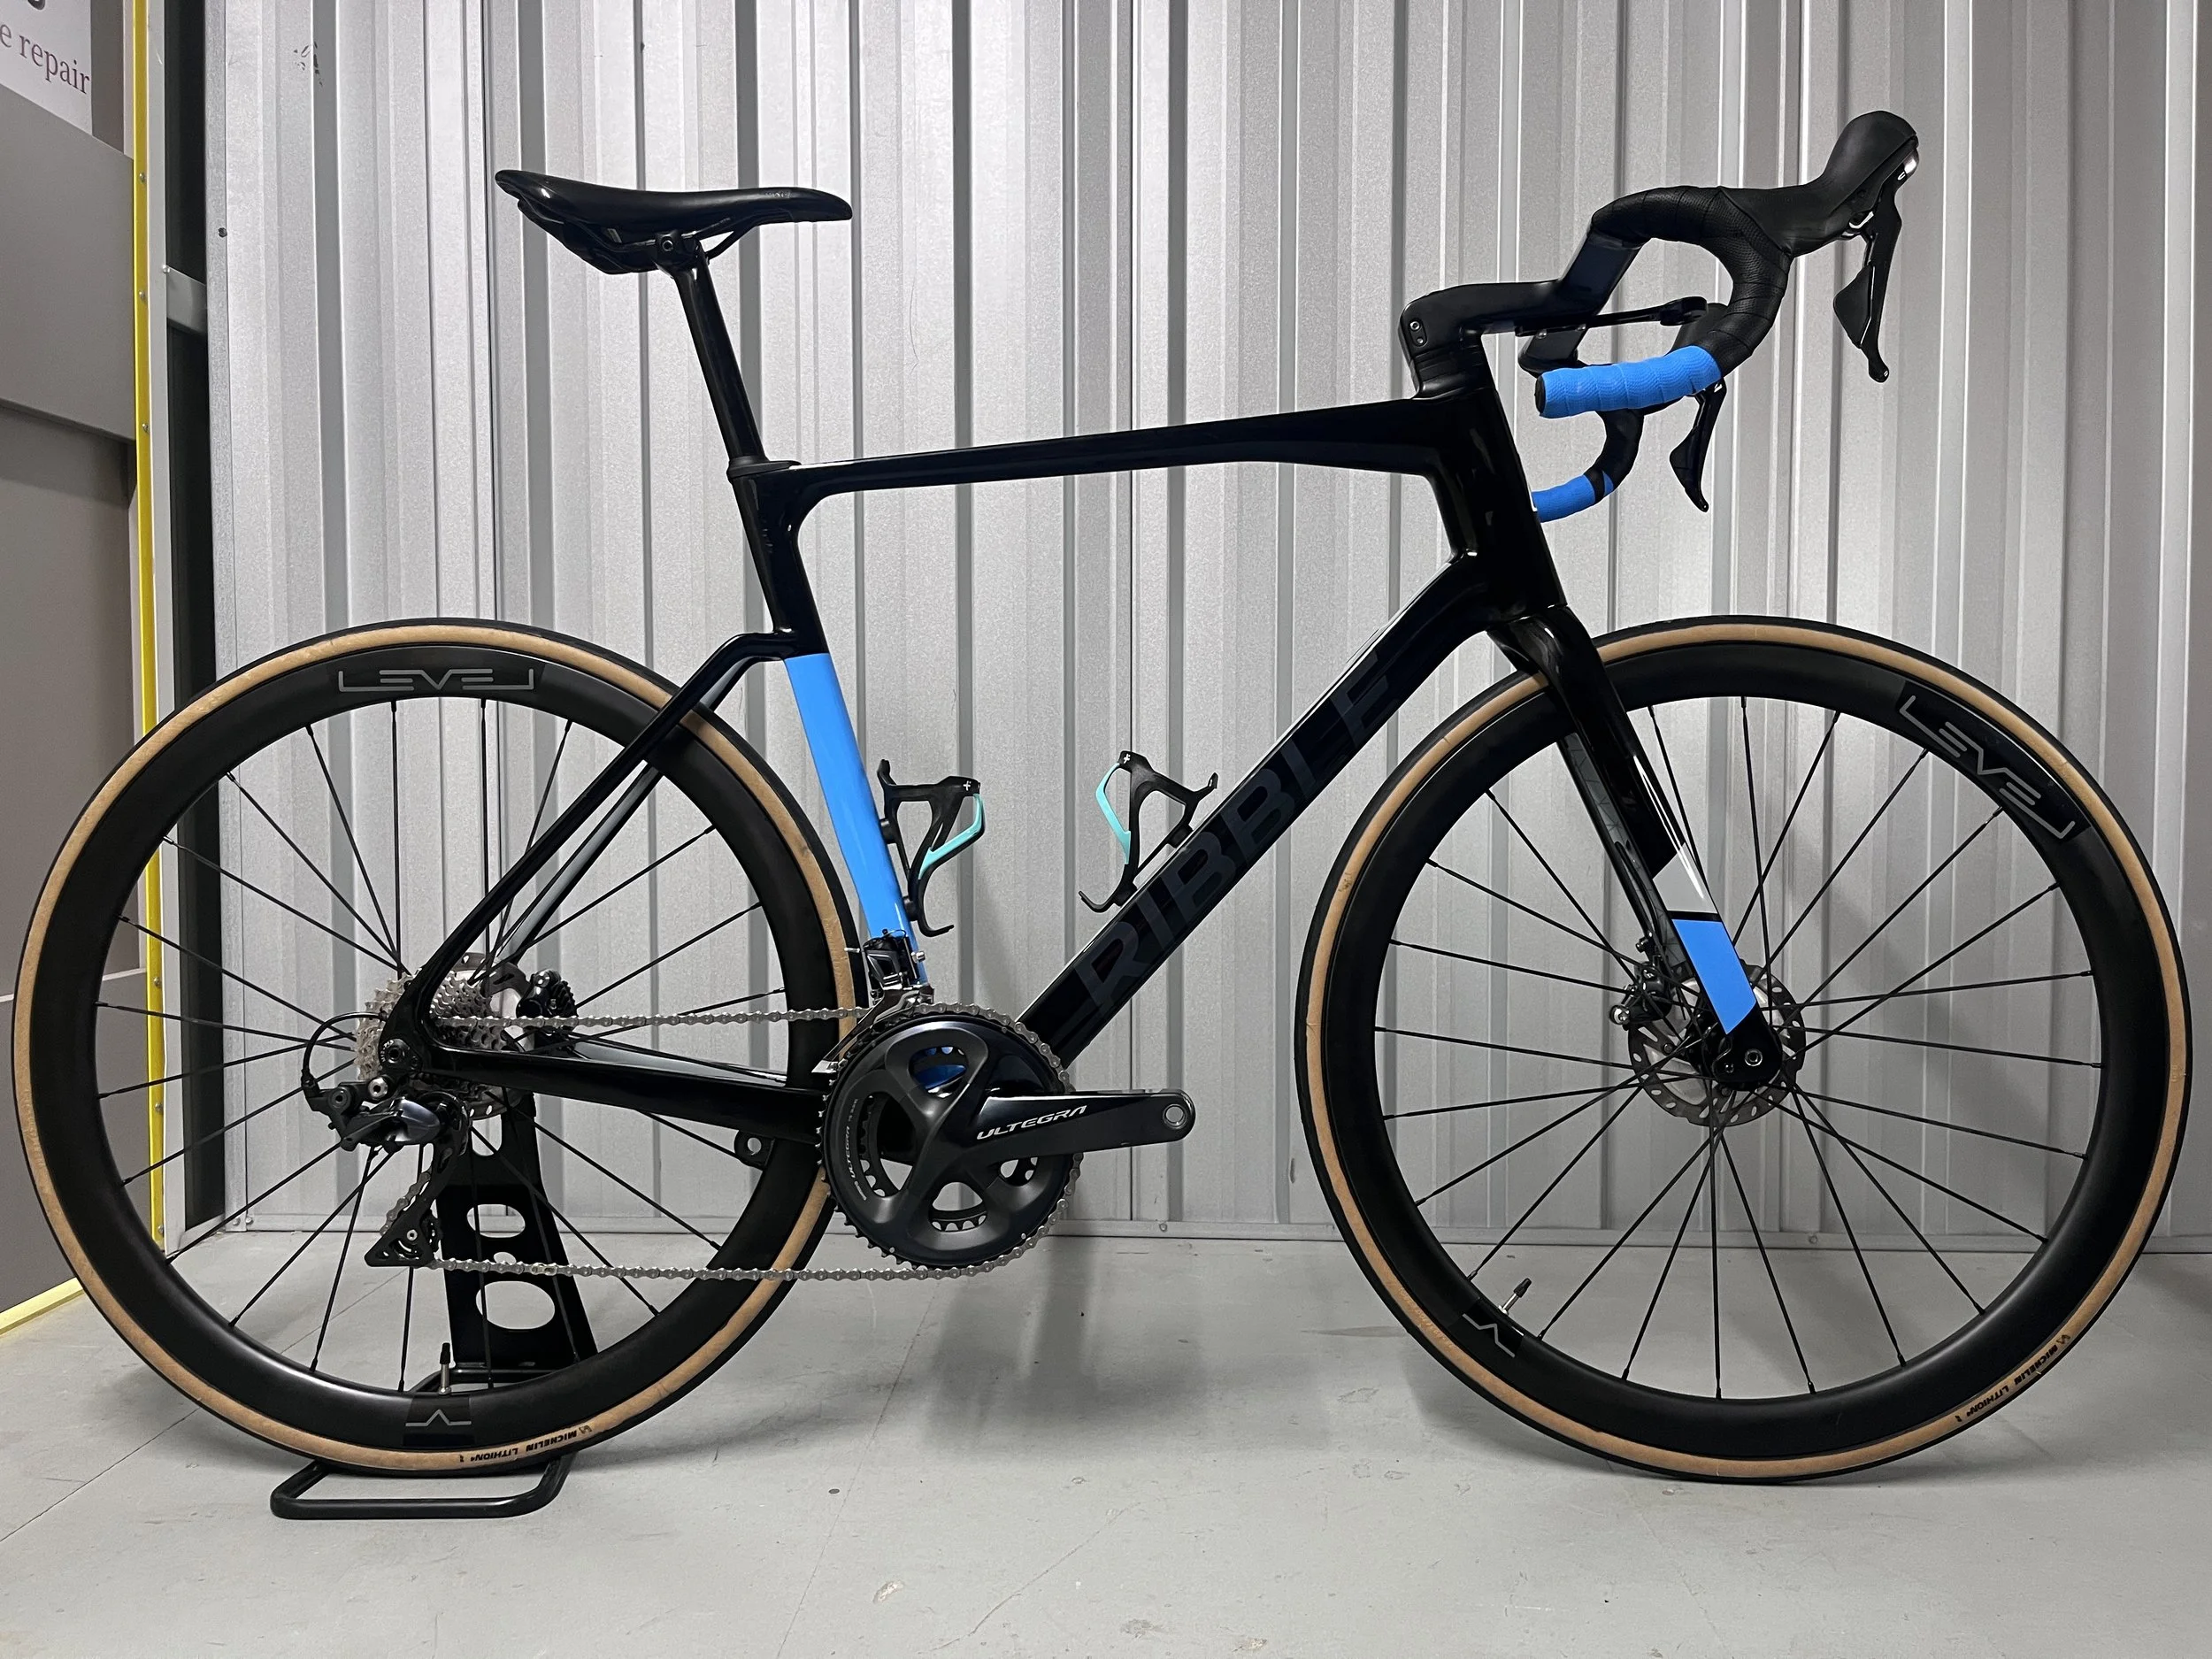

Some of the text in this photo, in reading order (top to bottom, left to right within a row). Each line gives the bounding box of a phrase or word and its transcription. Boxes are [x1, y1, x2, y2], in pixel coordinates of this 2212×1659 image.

[19, 35, 90, 95] repair
[338, 667, 534, 692] LEVEL
[1899, 695, 2076, 839] LEVEL
[976, 1105, 1087, 1140] ULTEGRA
[2013, 1344, 2058, 1386] MICHELIN
[526, 1430, 577, 1452] MICHELIN
